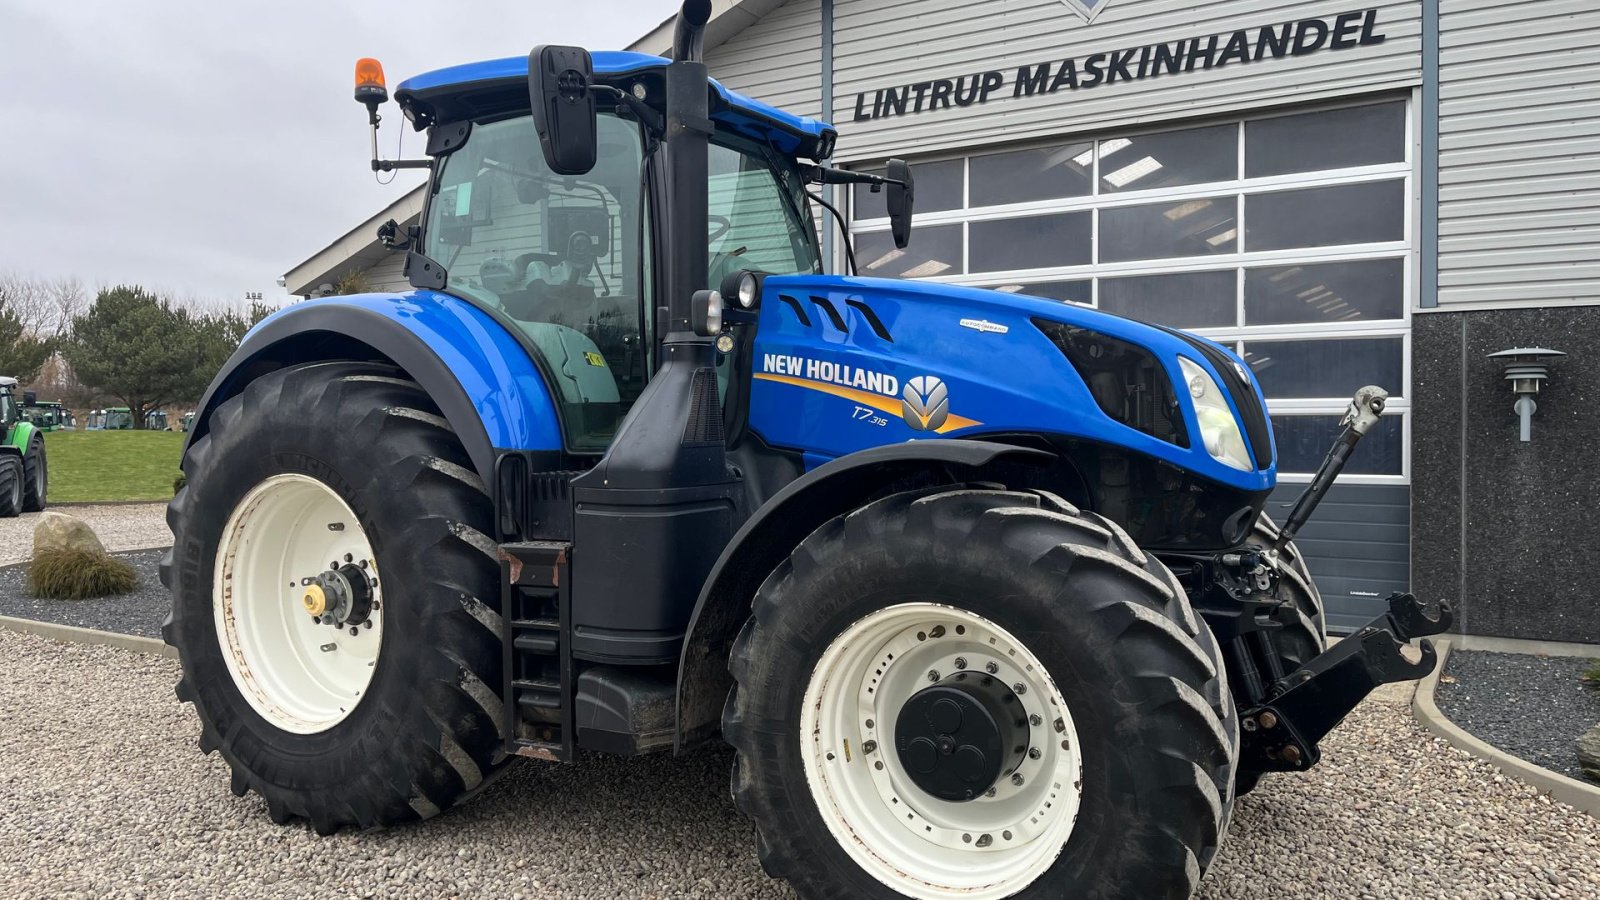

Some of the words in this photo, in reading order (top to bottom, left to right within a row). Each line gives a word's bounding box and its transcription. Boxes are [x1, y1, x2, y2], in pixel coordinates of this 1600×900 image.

[854, 71, 1003, 122] LINTRUP
[1013, 9, 1386, 98] MASKINHANDEL
[764, 354, 803, 375] NEW
[807, 359, 898, 395] HOLLAND
